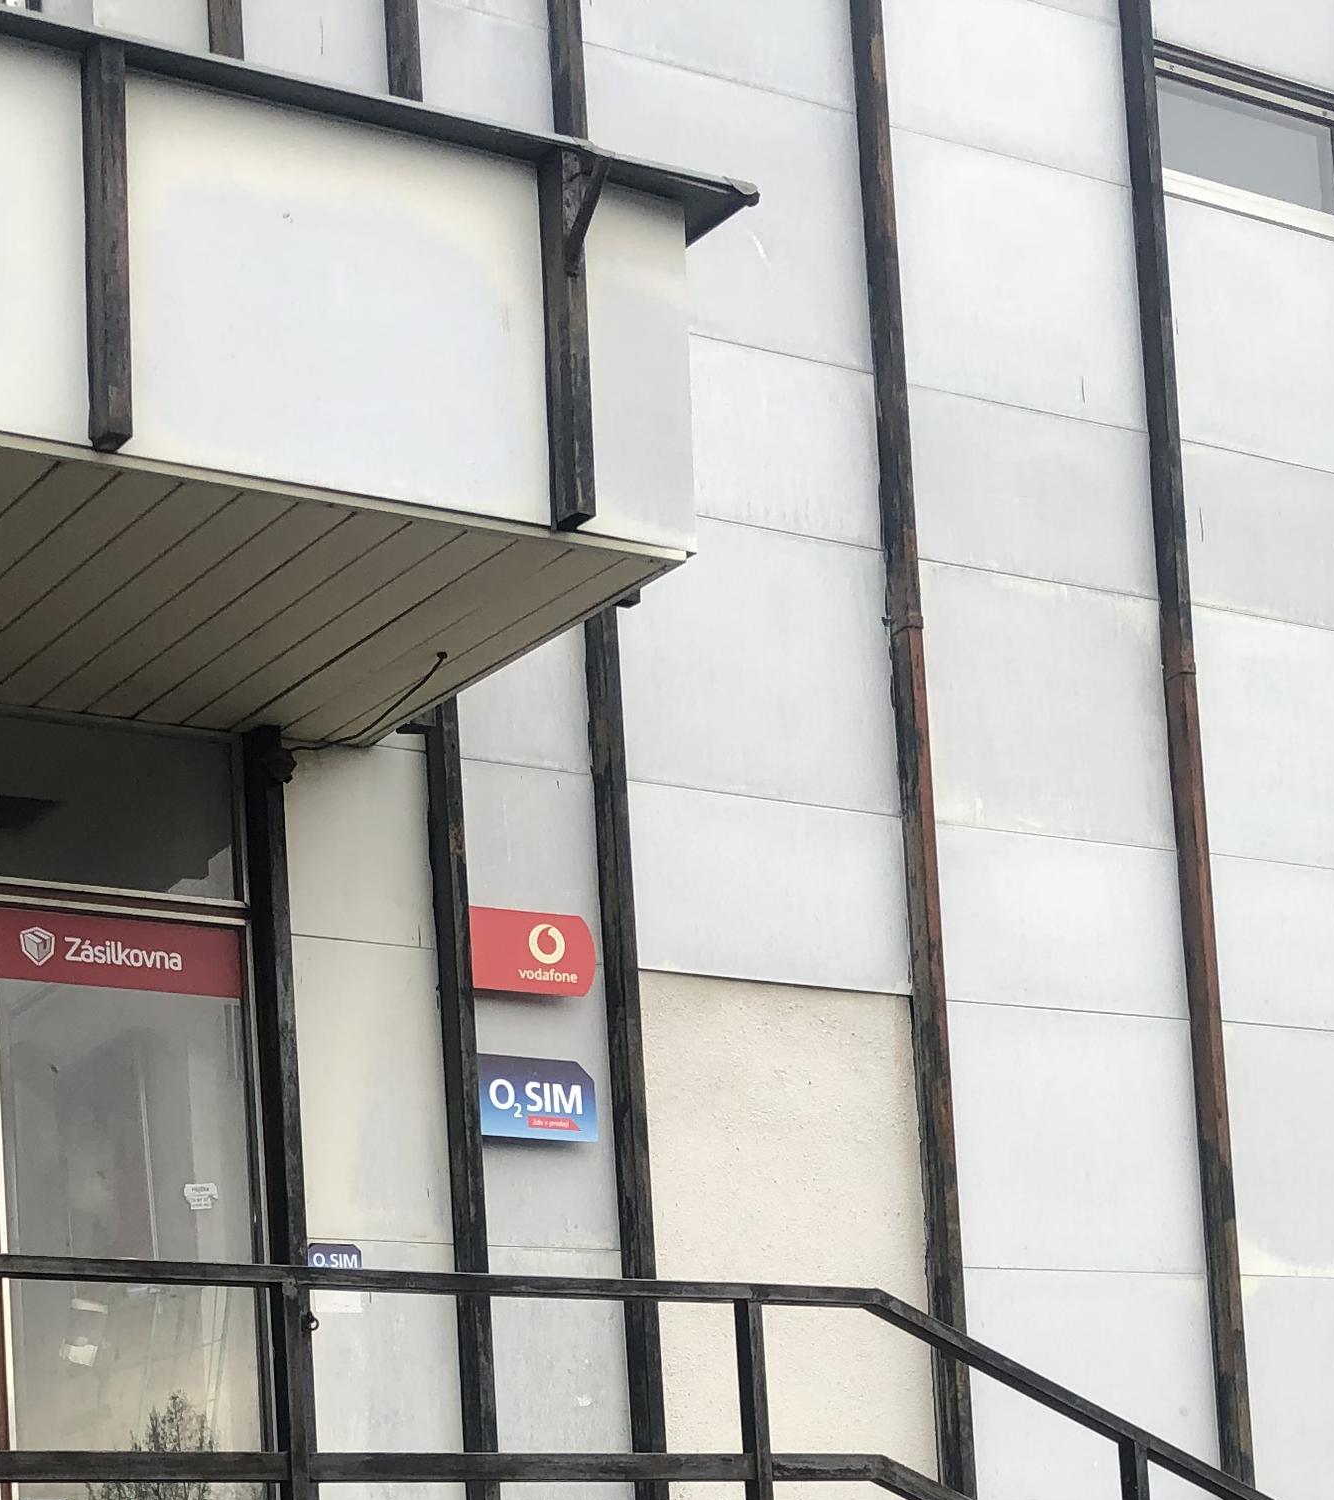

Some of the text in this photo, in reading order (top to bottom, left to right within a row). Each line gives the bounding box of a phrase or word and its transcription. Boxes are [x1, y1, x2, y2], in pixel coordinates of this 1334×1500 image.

[64, 936, 183, 971] Zásilkovna
[518, 968, 579, 984] vodafone
[525, 1081, 583, 1115] SIM
[330, 1253, 358, 1269] SIM
